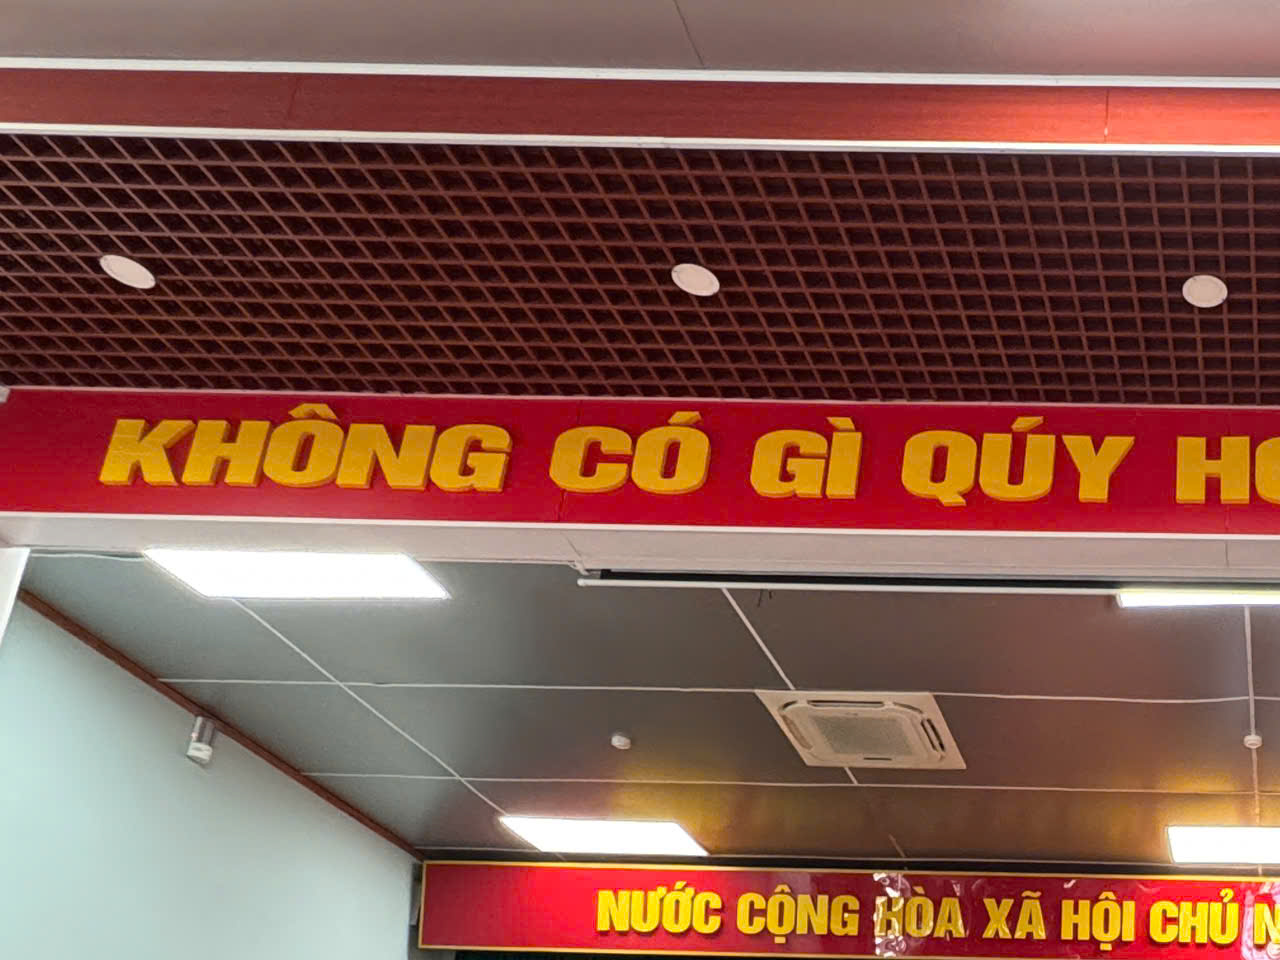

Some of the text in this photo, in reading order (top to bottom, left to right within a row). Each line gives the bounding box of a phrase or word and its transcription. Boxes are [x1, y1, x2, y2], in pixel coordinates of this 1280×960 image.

[99, 403, 514, 493] KHÔNG
[549, 411, 710, 496] CÓ
[749, 416, 860, 500] GÌ
[900, 416, 1135, 507] QÚY
[596, 885, 723, 935] NƯỚC
[737, 885, 860, 944] CỘNG
[875, 886, 966, 938] HÒA
[983, 888, 1044, 941] XÃ
[1060, 892, 1136, 950] HỘI
[1149, 888, 1239, 947] CHỦ
